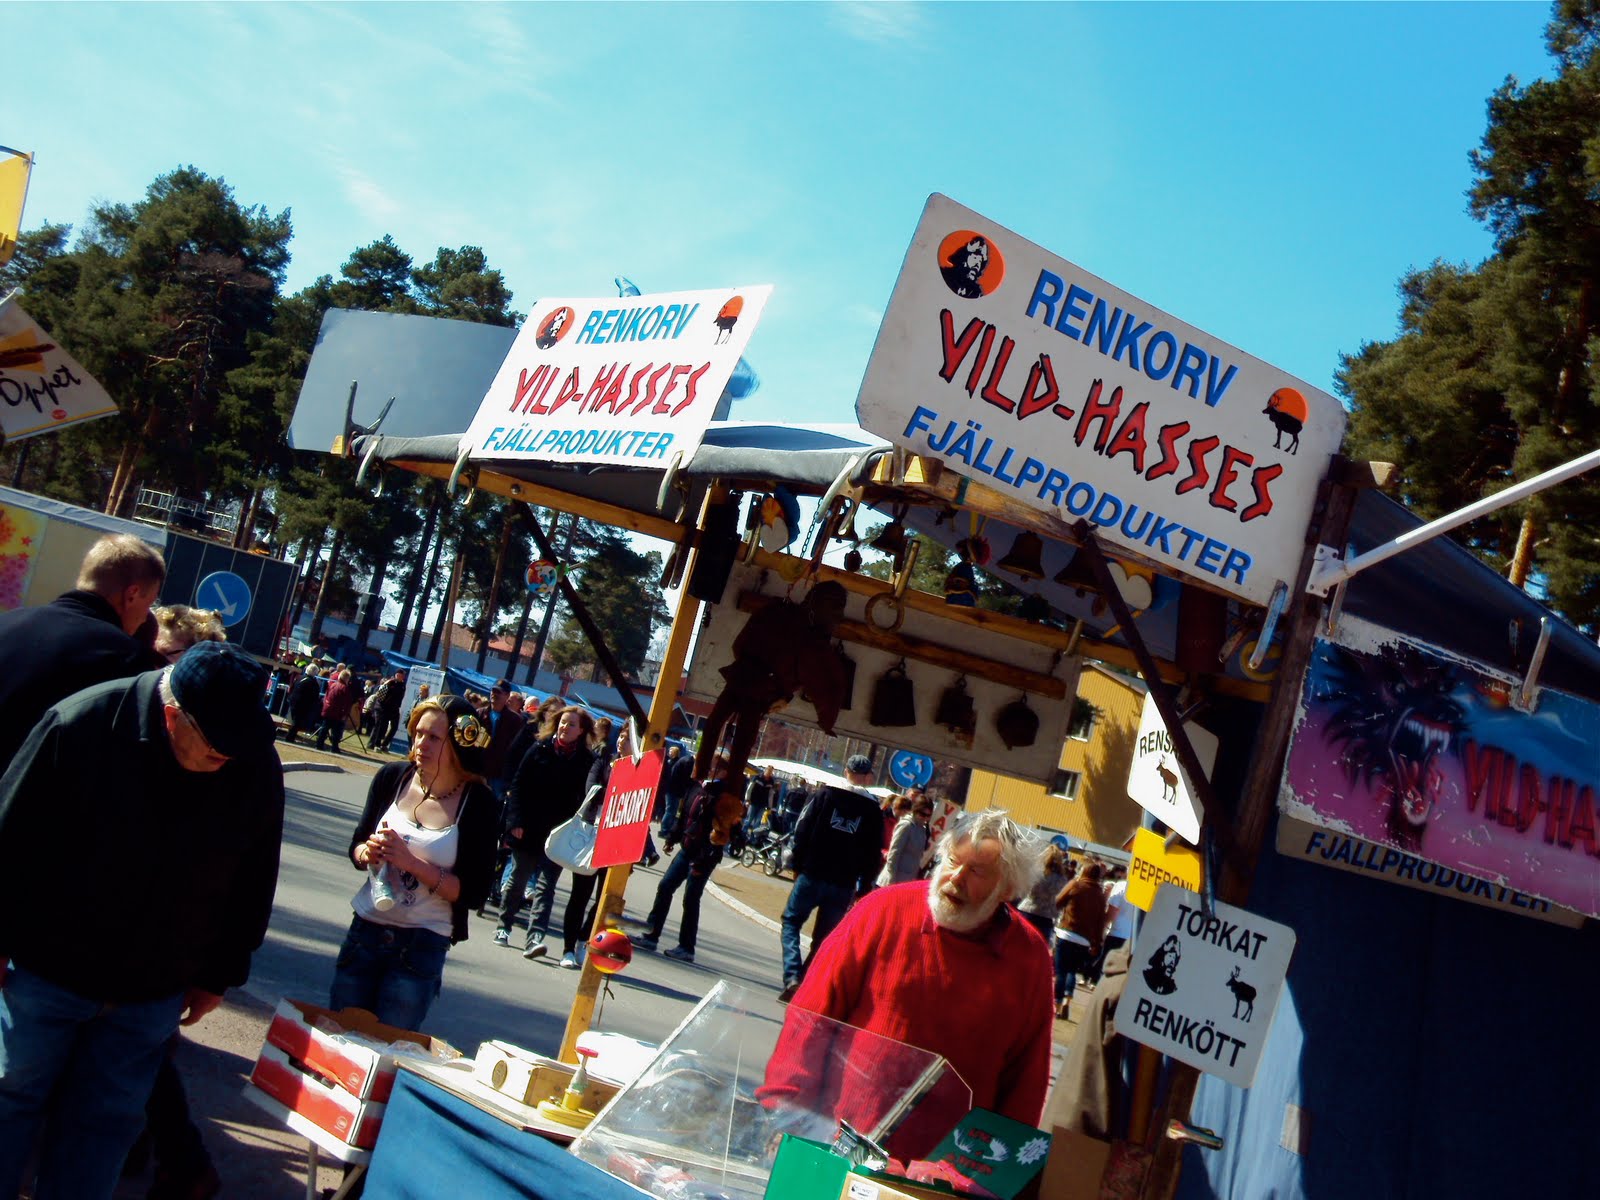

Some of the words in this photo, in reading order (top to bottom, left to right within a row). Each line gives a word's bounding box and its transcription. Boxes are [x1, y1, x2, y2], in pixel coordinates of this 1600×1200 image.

[575, 303, 700, 344] RENKORV
[1024, 268, 1238, 407] RENKORV
[0, 364, 82, 413] Öppet
[509, 361, 711, 417] VILD-HASSES
[939, 308, 1283, 522] VILD-HASSES
[482, 422, 675, 459] FJÄLLPRODUKTER
[902, 405, 1252, 586] FJÄLLPRODUKTER
[1465, 736, 1600, 862] VILD-HA
[1176, 903, 1268, 961] TORKAT
[1133, 997, 1246, 1068] RENKÖTT
